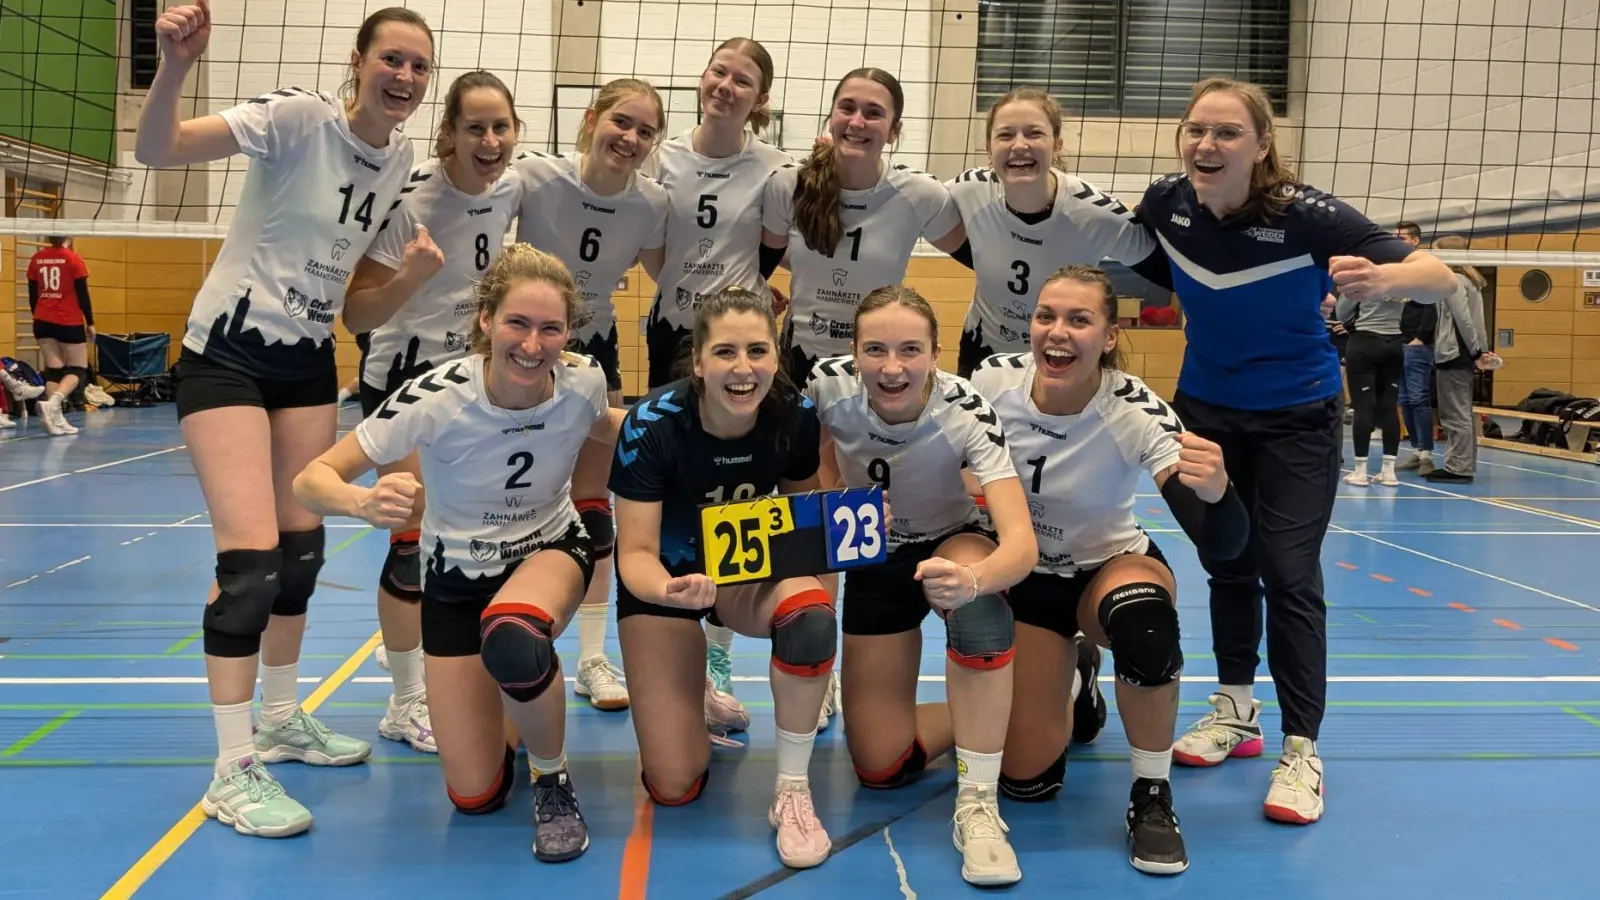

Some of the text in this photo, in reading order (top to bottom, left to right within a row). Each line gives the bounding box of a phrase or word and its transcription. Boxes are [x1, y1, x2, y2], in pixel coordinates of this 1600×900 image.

[338, 183, 377, 233] 14
[696, 194, 718, 229] 5
[1170, 213, 1191, 228] JAKO
[474, 233, 490, 271] 8
[579, 228, 602, 262] 6
[39, 266, 60, 291] 18
[1007, 260, 1031, 295] 3
[1038, 427, 1067, 441] hummel
[504, 451, 534, 490] 2
[722, 453, 752, 465] hummel
[867, 457, 891, 490] 9
[1027, 455, 1047, 494] 1
[768, 507, 784, 531] 3
[833, 503, 882, 562] 23
[714, 518, 765, 577] 25
